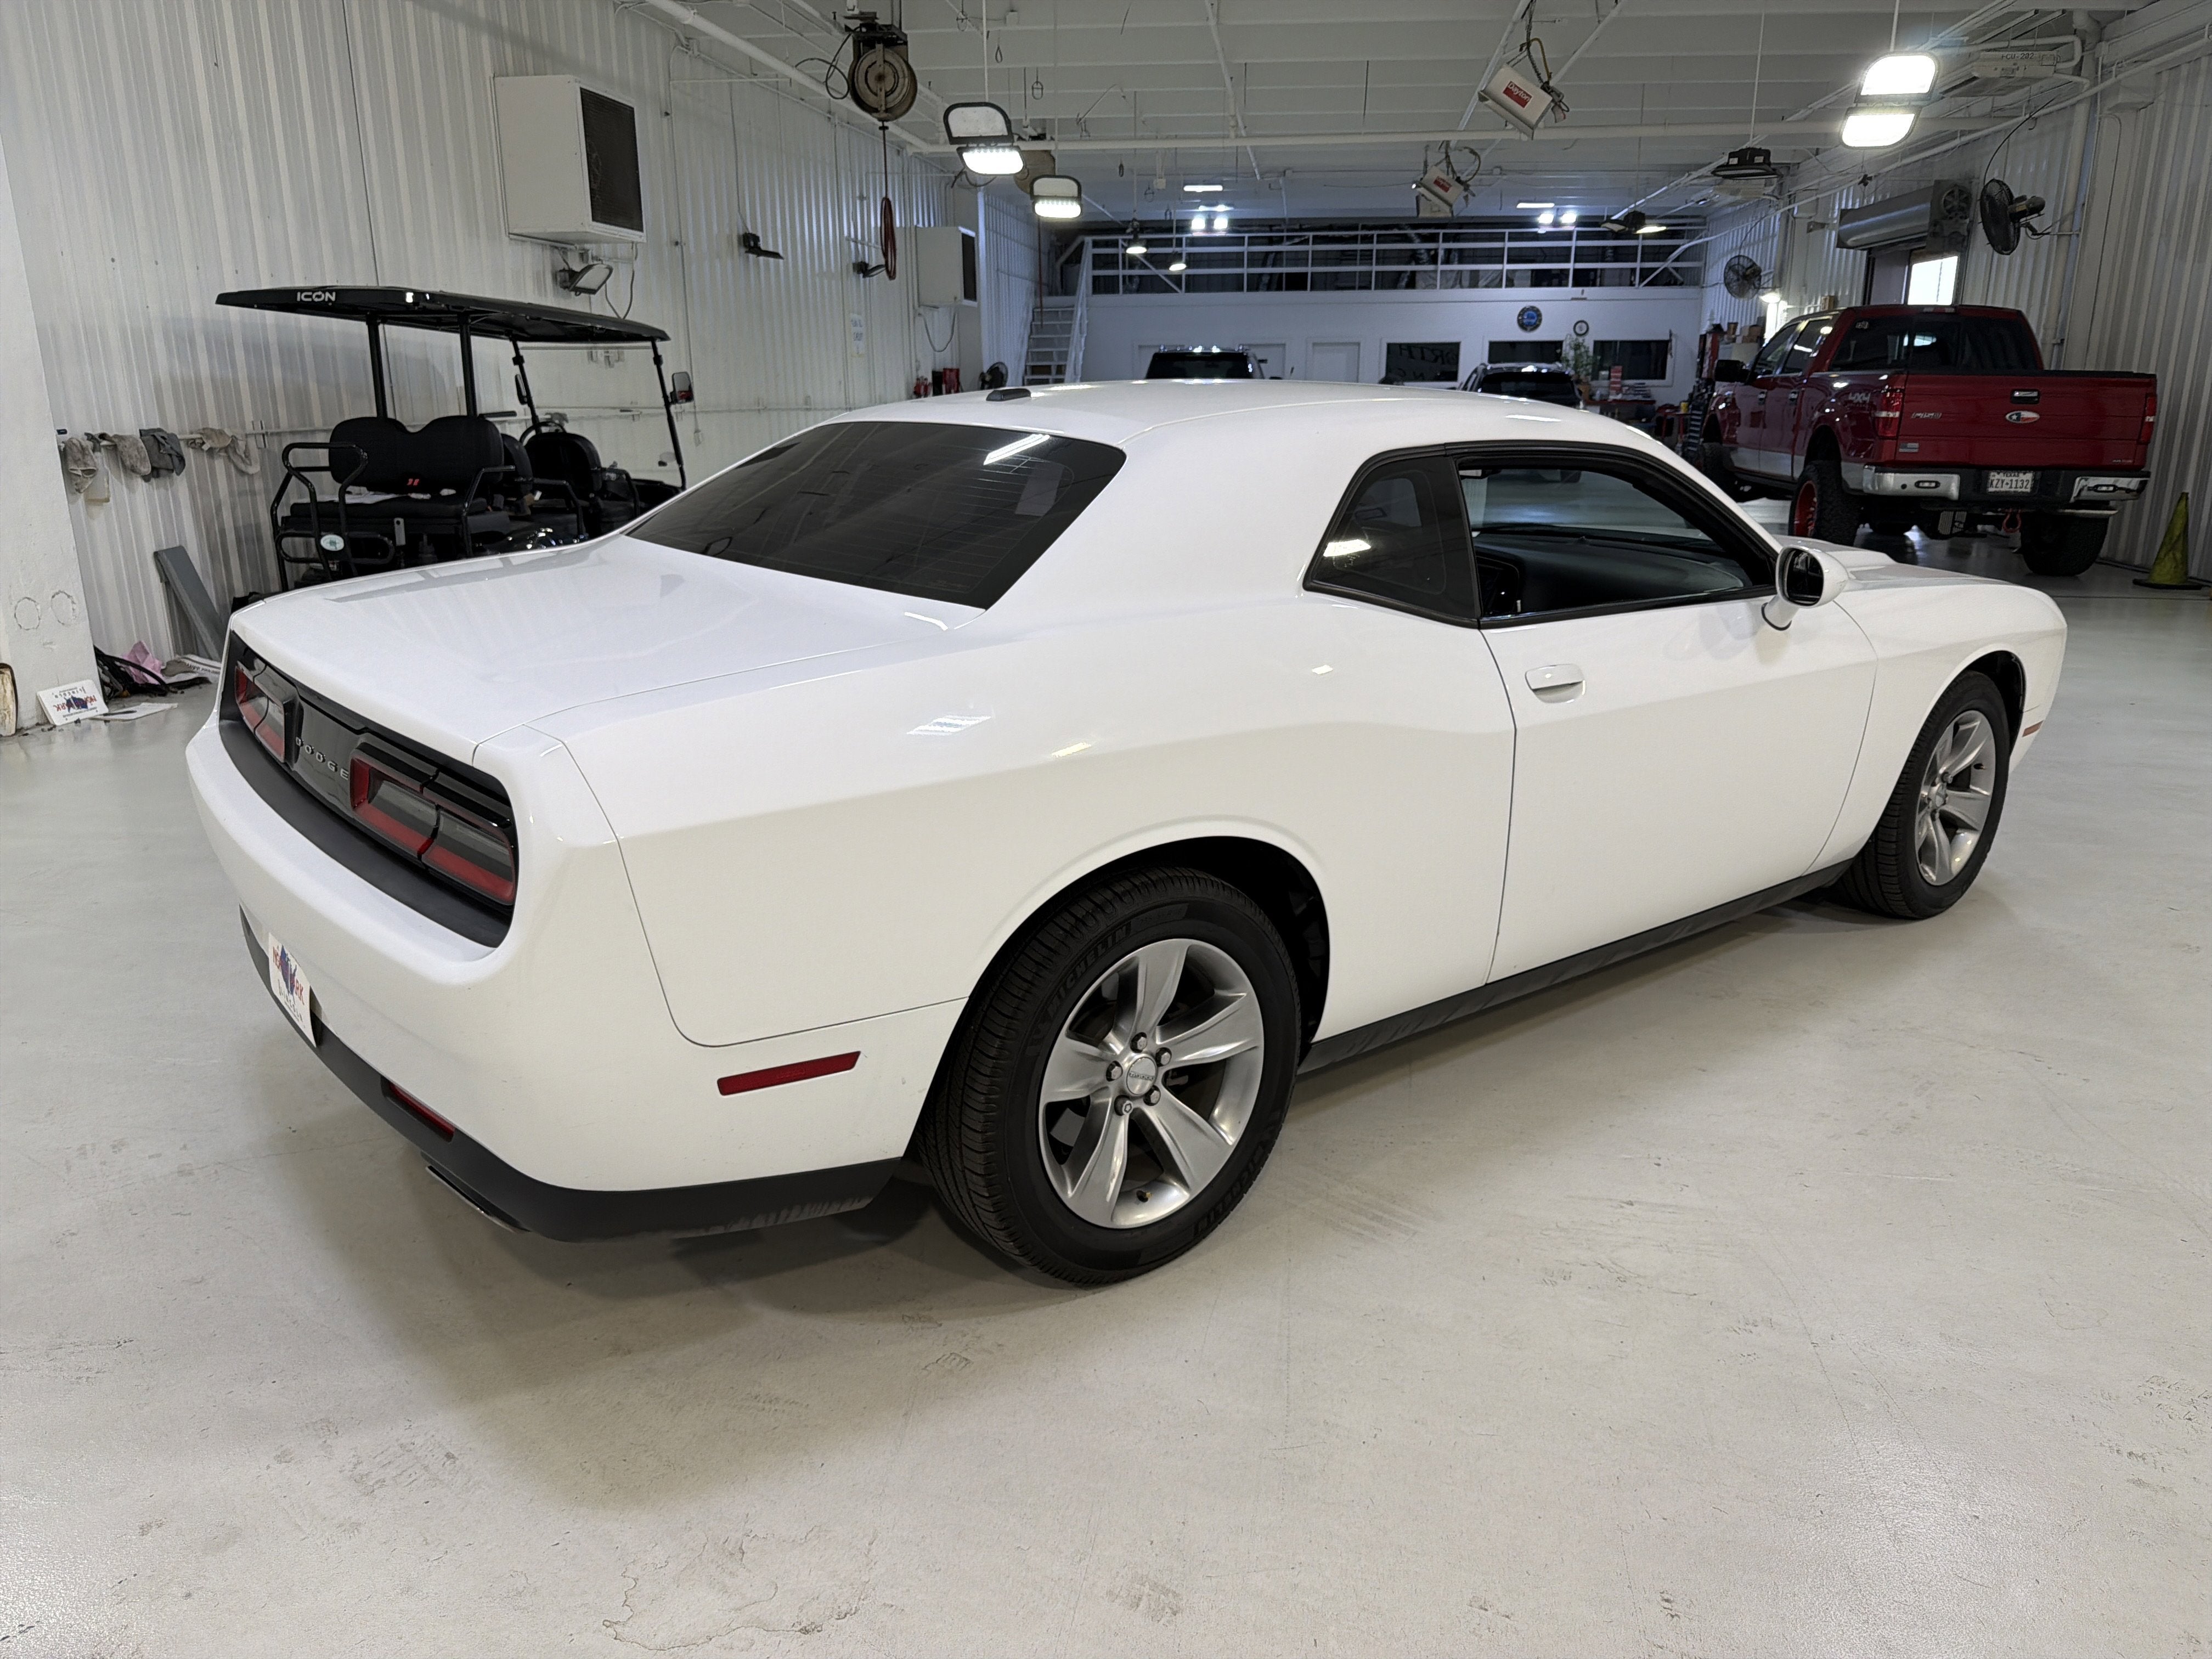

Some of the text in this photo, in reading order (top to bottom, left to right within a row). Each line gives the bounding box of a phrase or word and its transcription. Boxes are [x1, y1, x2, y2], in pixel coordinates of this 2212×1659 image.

[1508, 82, 1530, 101] Dayton
[297, 291, 336, 302] ICON
[296, 737, 349, 780] DODGE
[1046, 920, 1132, 1016] MICHELIN
